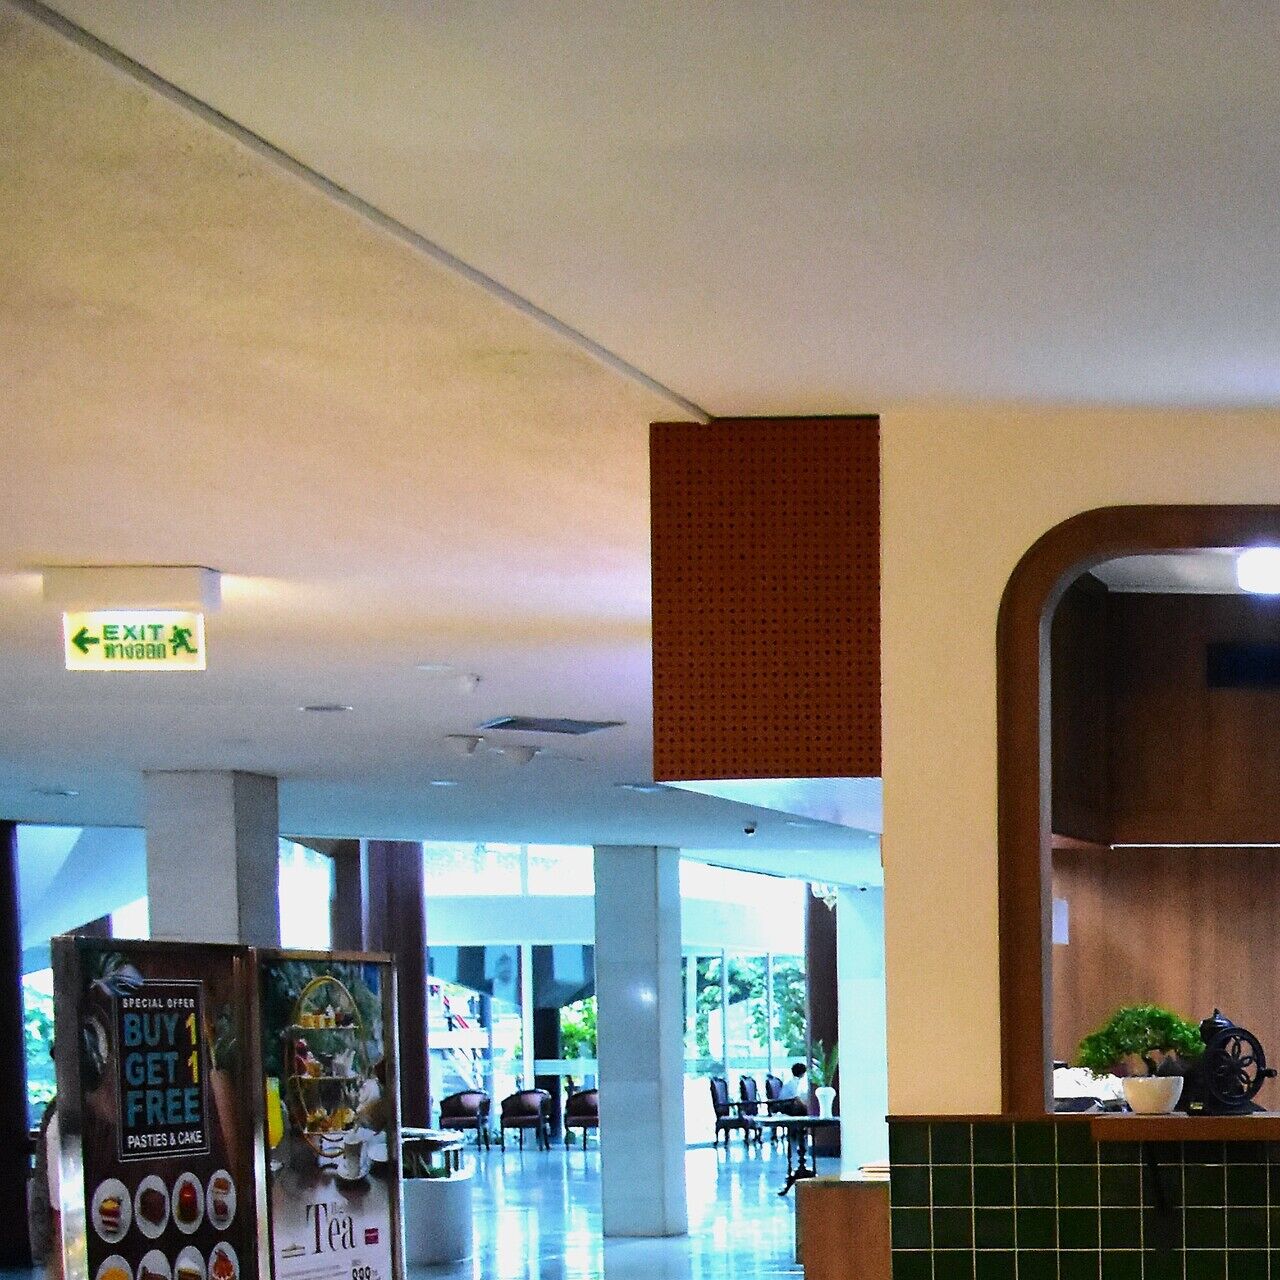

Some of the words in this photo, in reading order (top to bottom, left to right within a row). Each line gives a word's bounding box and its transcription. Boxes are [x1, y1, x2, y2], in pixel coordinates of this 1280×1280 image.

[102, 624, 164, 640] EXIT
[104, 642, 166, 659] ทางออก
[122, 998, 164, 1008] SPECIAL
[167, 998, 195, 1008] OFFER
[123, 1012, 179, 1047] BUY
[185, 1012, 198, 1046] 1
[125, 1051, 179, 1086] GET
[187, 1050, 199, 1084] 1
[127, 1087, 200, 1127] FREE
[127, 1132, 168, 1149] PASTIES
[169, 1132, 177, 1146] &
[178, 1130, 203, 1145] CAKE
[306, 1203, 356, 1255] Tea
